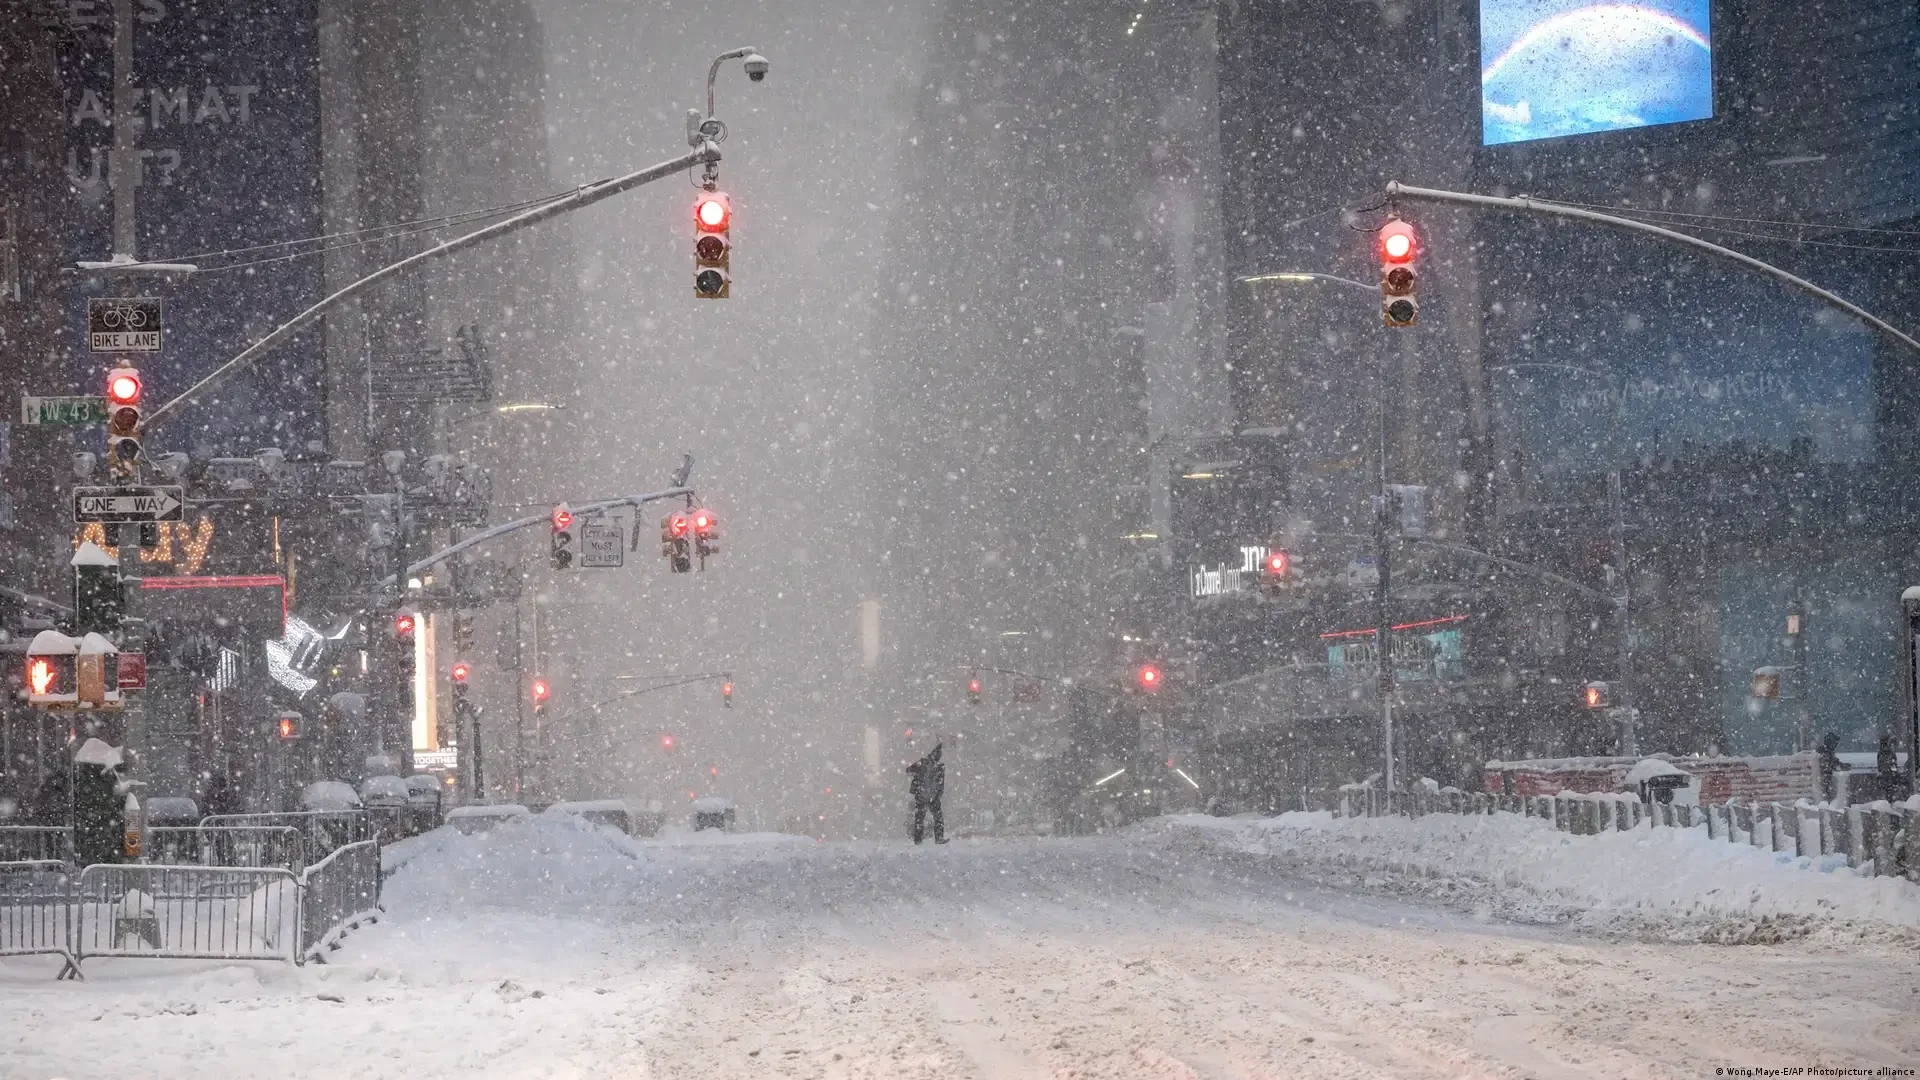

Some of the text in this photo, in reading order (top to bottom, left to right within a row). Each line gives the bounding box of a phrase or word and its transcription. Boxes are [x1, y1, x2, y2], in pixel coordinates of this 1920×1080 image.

[93, 332, 157, 347] BIKE LANE
[44, 400, 90, 421] W 43
[84, 497, 168, 512] ONE WAY
[591, 542, 612, 551] MUST
[414, 756, 457, 764] TOGETHER
